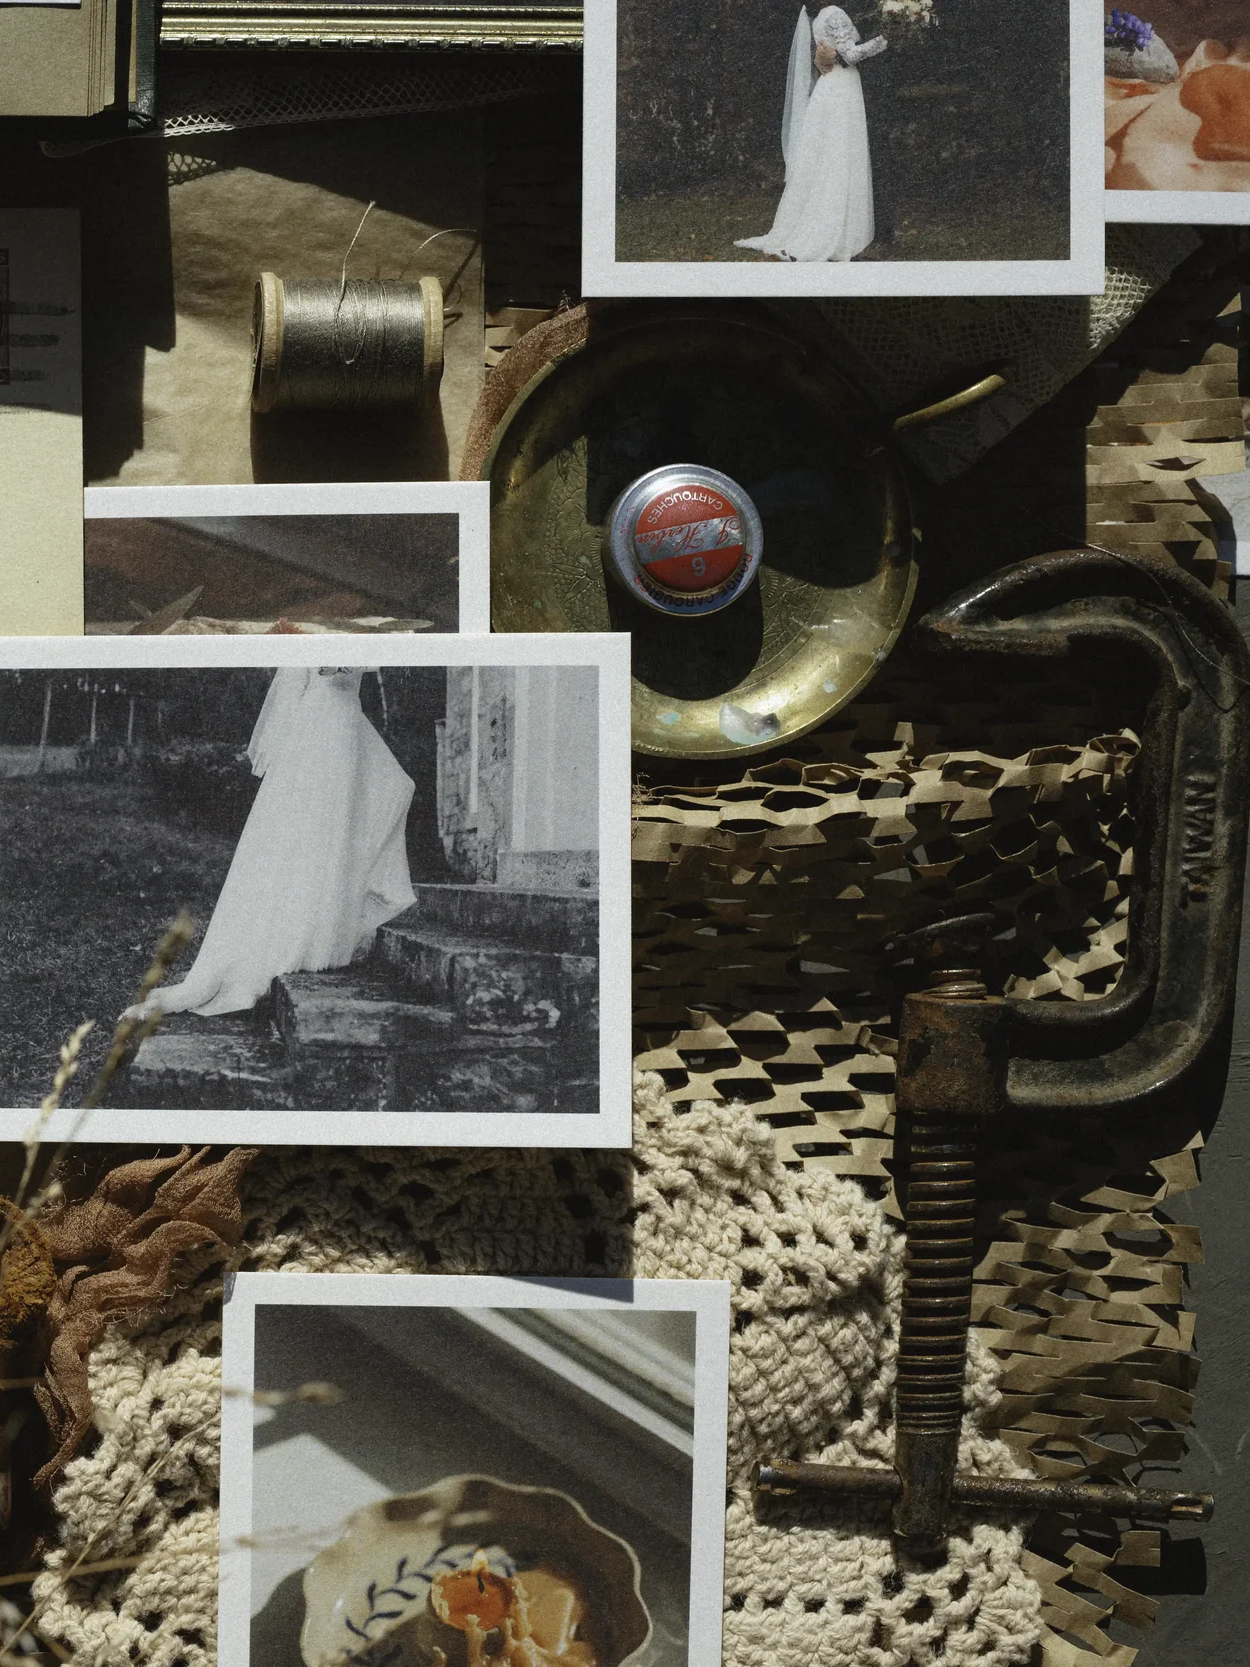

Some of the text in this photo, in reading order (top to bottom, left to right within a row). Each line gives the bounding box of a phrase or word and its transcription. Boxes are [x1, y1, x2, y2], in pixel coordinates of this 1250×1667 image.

[647, 490, 723, 525] CARTOUCHES
[636, 521, 708, 553] Herbin
[690, 556, 707, 577] 6
